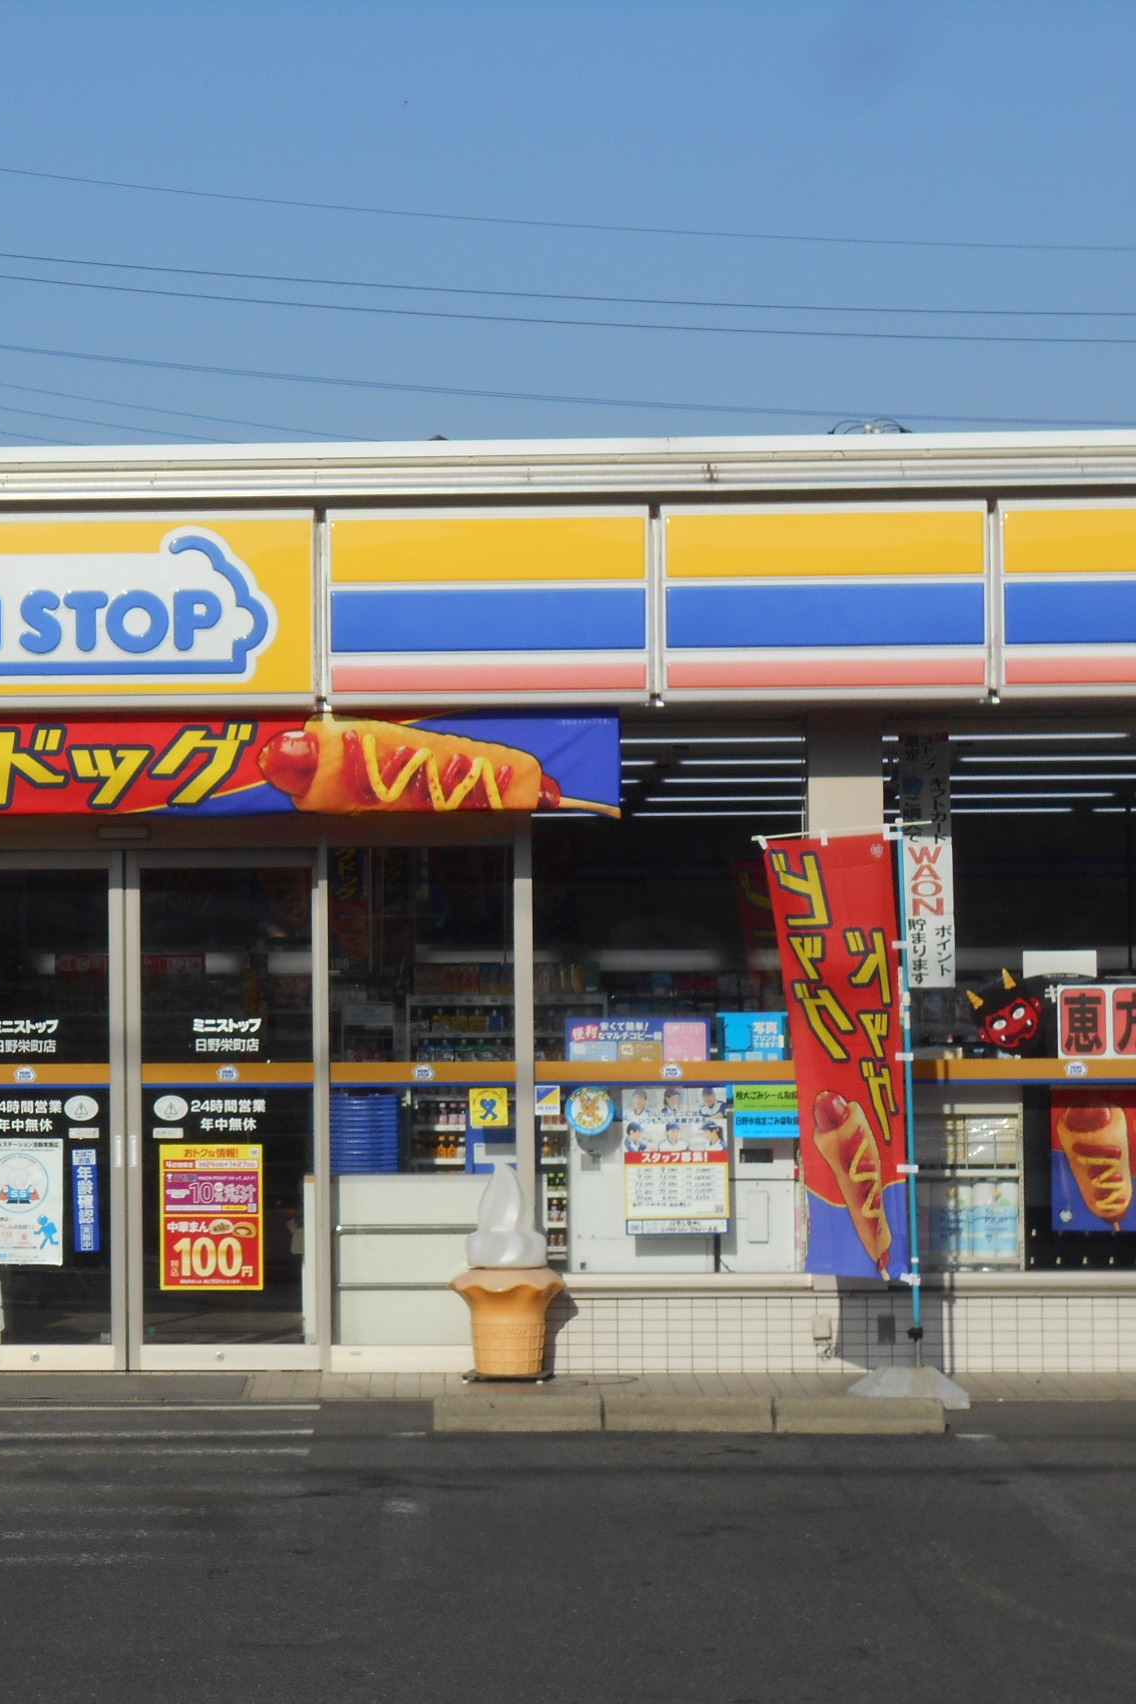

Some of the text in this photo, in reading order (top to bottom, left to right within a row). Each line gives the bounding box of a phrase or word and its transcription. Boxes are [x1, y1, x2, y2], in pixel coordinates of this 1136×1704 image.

[18, 588, 222, 654] STOP
[907, 846, 944, 917] WAON
[907, 918, 929, 985] 貯まります
[935, 924, 953, 977] ポイント
[192, 1018, 262, 1033] ミニストップ
[572, 1024, 599, 1041] 便利
[752, 1022, 779, 1035] 写真
[195, 1037, 260, 1052] 日野栄町店
[190, 1098, 267, 1113] 24時間営業
[200, 1117, 257, 1131] 年中無休
[641, 1152, 709, 1163] スタッフ募集!
[76, 1166, 95, 1224] 年齢確認
[188, 1181, 215, 1204] 10
[166, 1221, 210, 1234] 中華まん
[172, 1236, 243, 1278] 100
[241, 1265, 254, 1278] 円
